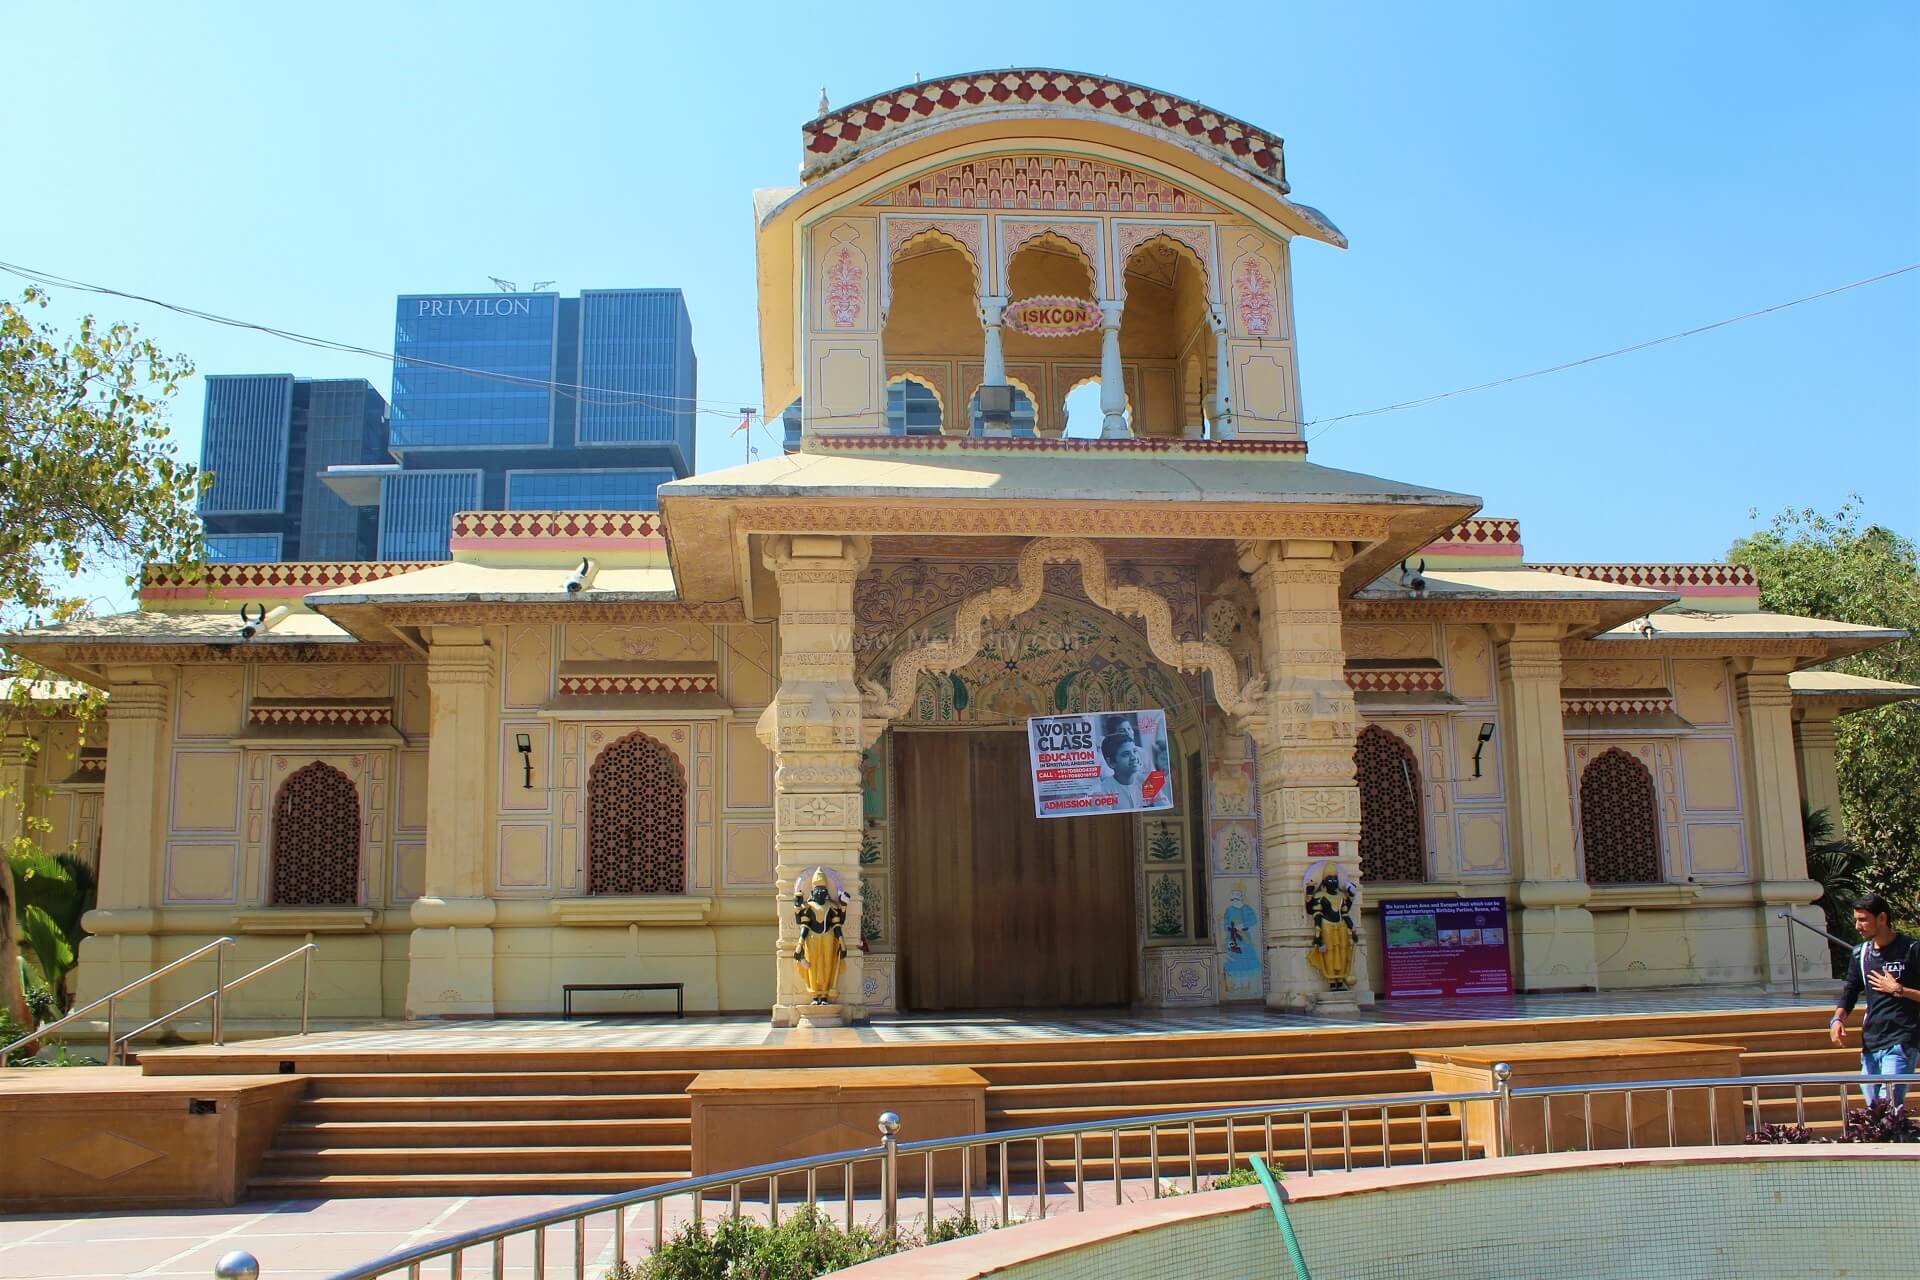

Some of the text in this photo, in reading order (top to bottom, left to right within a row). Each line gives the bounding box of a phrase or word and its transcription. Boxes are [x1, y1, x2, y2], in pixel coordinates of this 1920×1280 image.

[418, 299, 530, 317] PRIVILON
[1023, 309, 1086, 324] ISKCON
[1036, 722, 1092, 737] WORLD
[1038, 735, 1092, 751] CLASS
[1039, 751, 1095, 763] EDUCATION
[1044, 797, 1119, 810] ADMISSION OPEN
